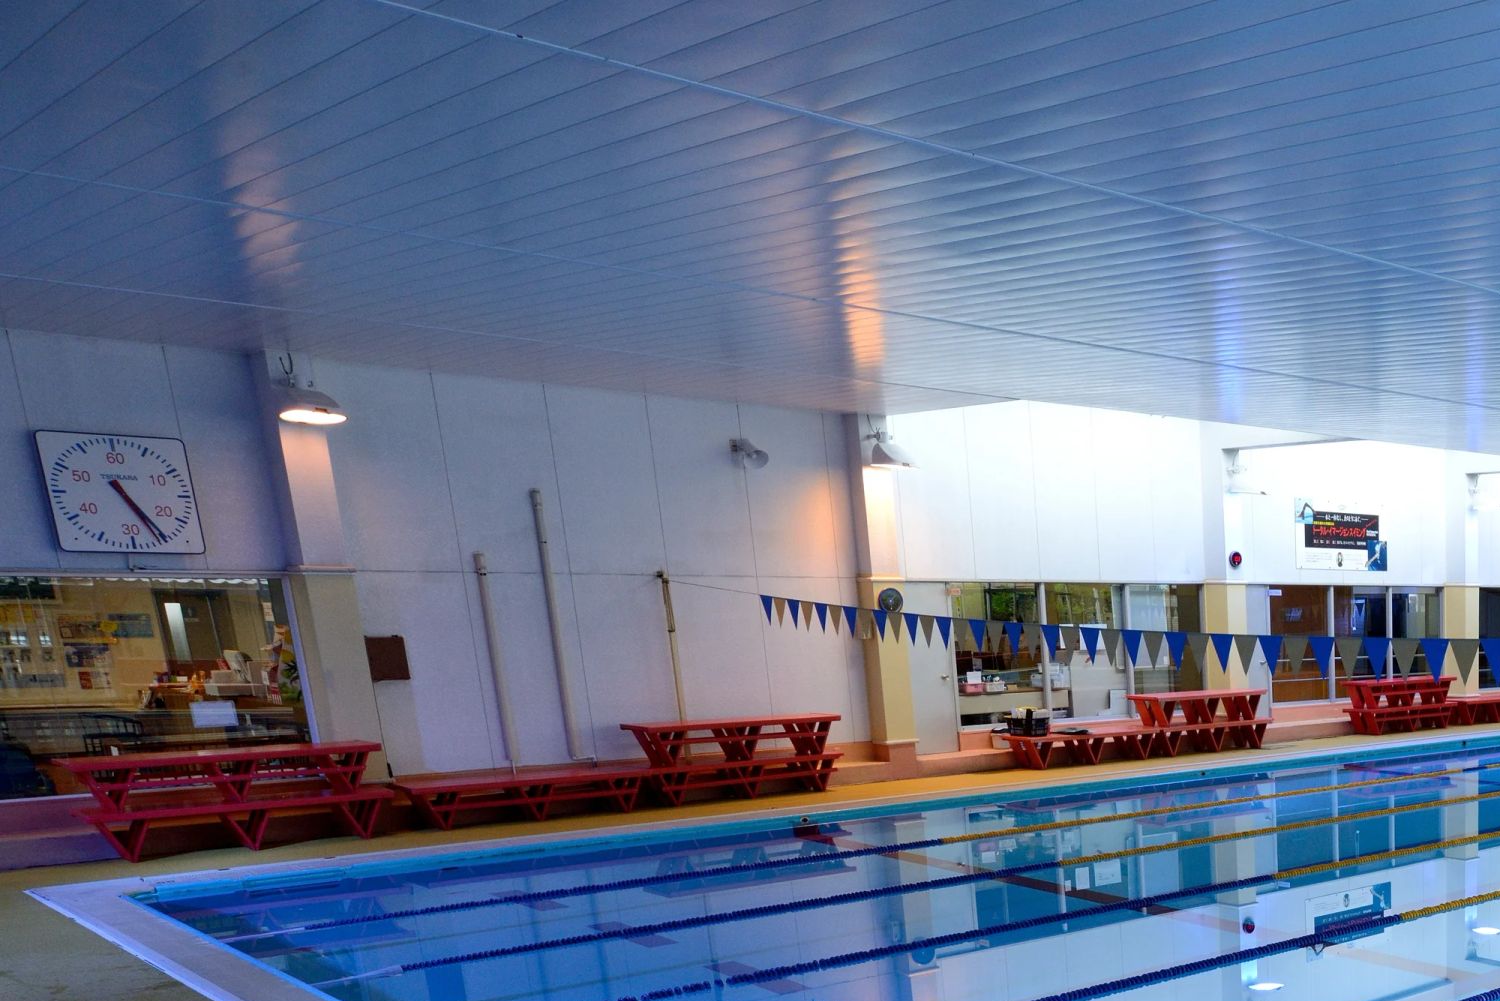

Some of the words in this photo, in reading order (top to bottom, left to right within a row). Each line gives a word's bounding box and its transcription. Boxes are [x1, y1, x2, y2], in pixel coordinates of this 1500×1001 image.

[106, 452, 125, 465] 60
[72, 470, 91, 483] 50
[149, 474, 167, 487] 10
[79, 502, 98, 515] 40
[155, 505, 173, 517] 20
[121, 523, 140, 536] 30
